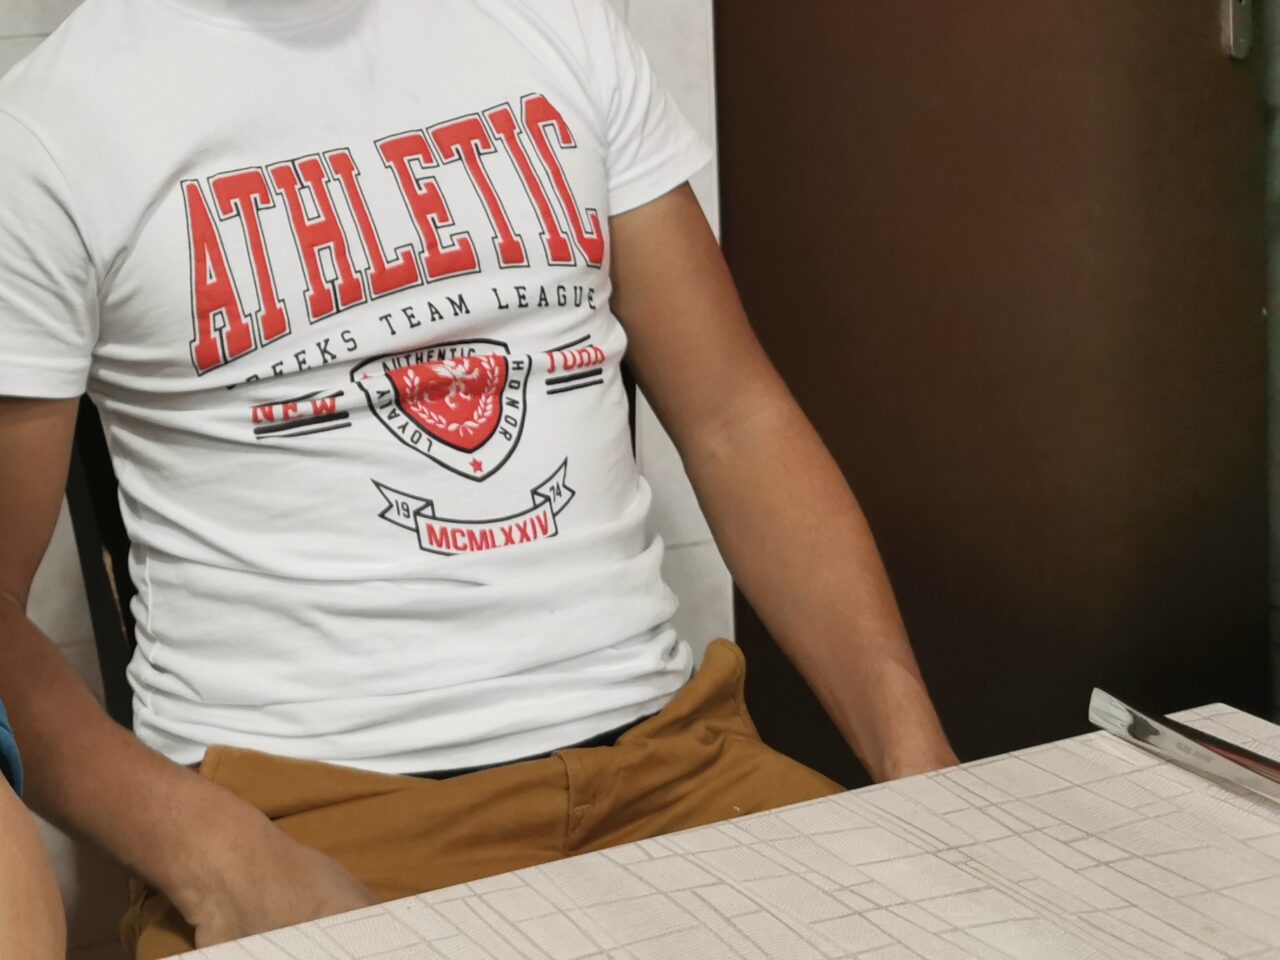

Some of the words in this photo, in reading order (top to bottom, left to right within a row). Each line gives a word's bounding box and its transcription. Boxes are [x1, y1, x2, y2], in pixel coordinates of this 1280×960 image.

[180, 92, 605, 376] ATHLETIC
[379, 294, 470, 335] TEAM
[492, 285, 596, 310] LEAGUE
[251, 397, 336, 424] NEW
[498, 360, 524, 441] HONOR
[395, 500, 410, 518] 19
[549, 482, 562, 502] 74
[425, 510, 549, 551] MCMLXXIV
